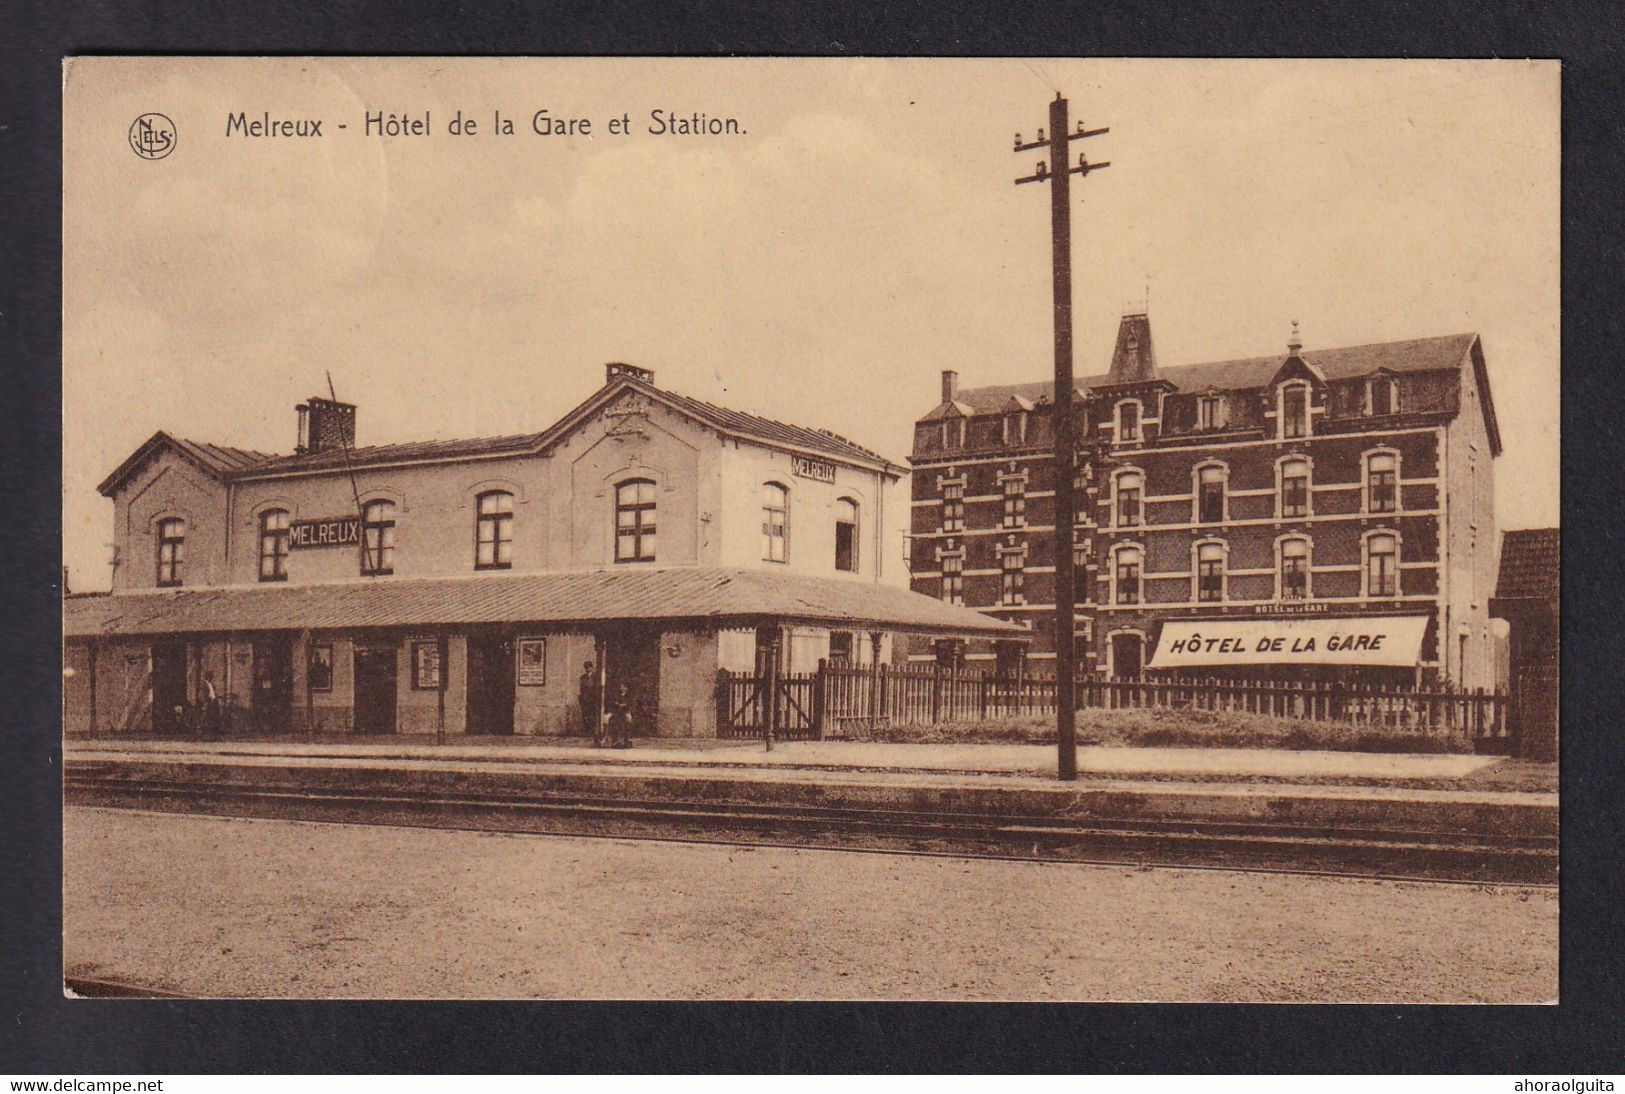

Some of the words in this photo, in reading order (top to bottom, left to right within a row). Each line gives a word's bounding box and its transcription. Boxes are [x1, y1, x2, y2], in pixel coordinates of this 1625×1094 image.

[793, 457, 835, 483] MELREUX
[289, 521, 359, 545] MELREUX
[1170, 633, 1246, 653] HÔTEL
[1255, 636, 1286, 652] DE
[1290, 637, 1317, 652] LA
[1326, 634, 1387, 651] GARE
